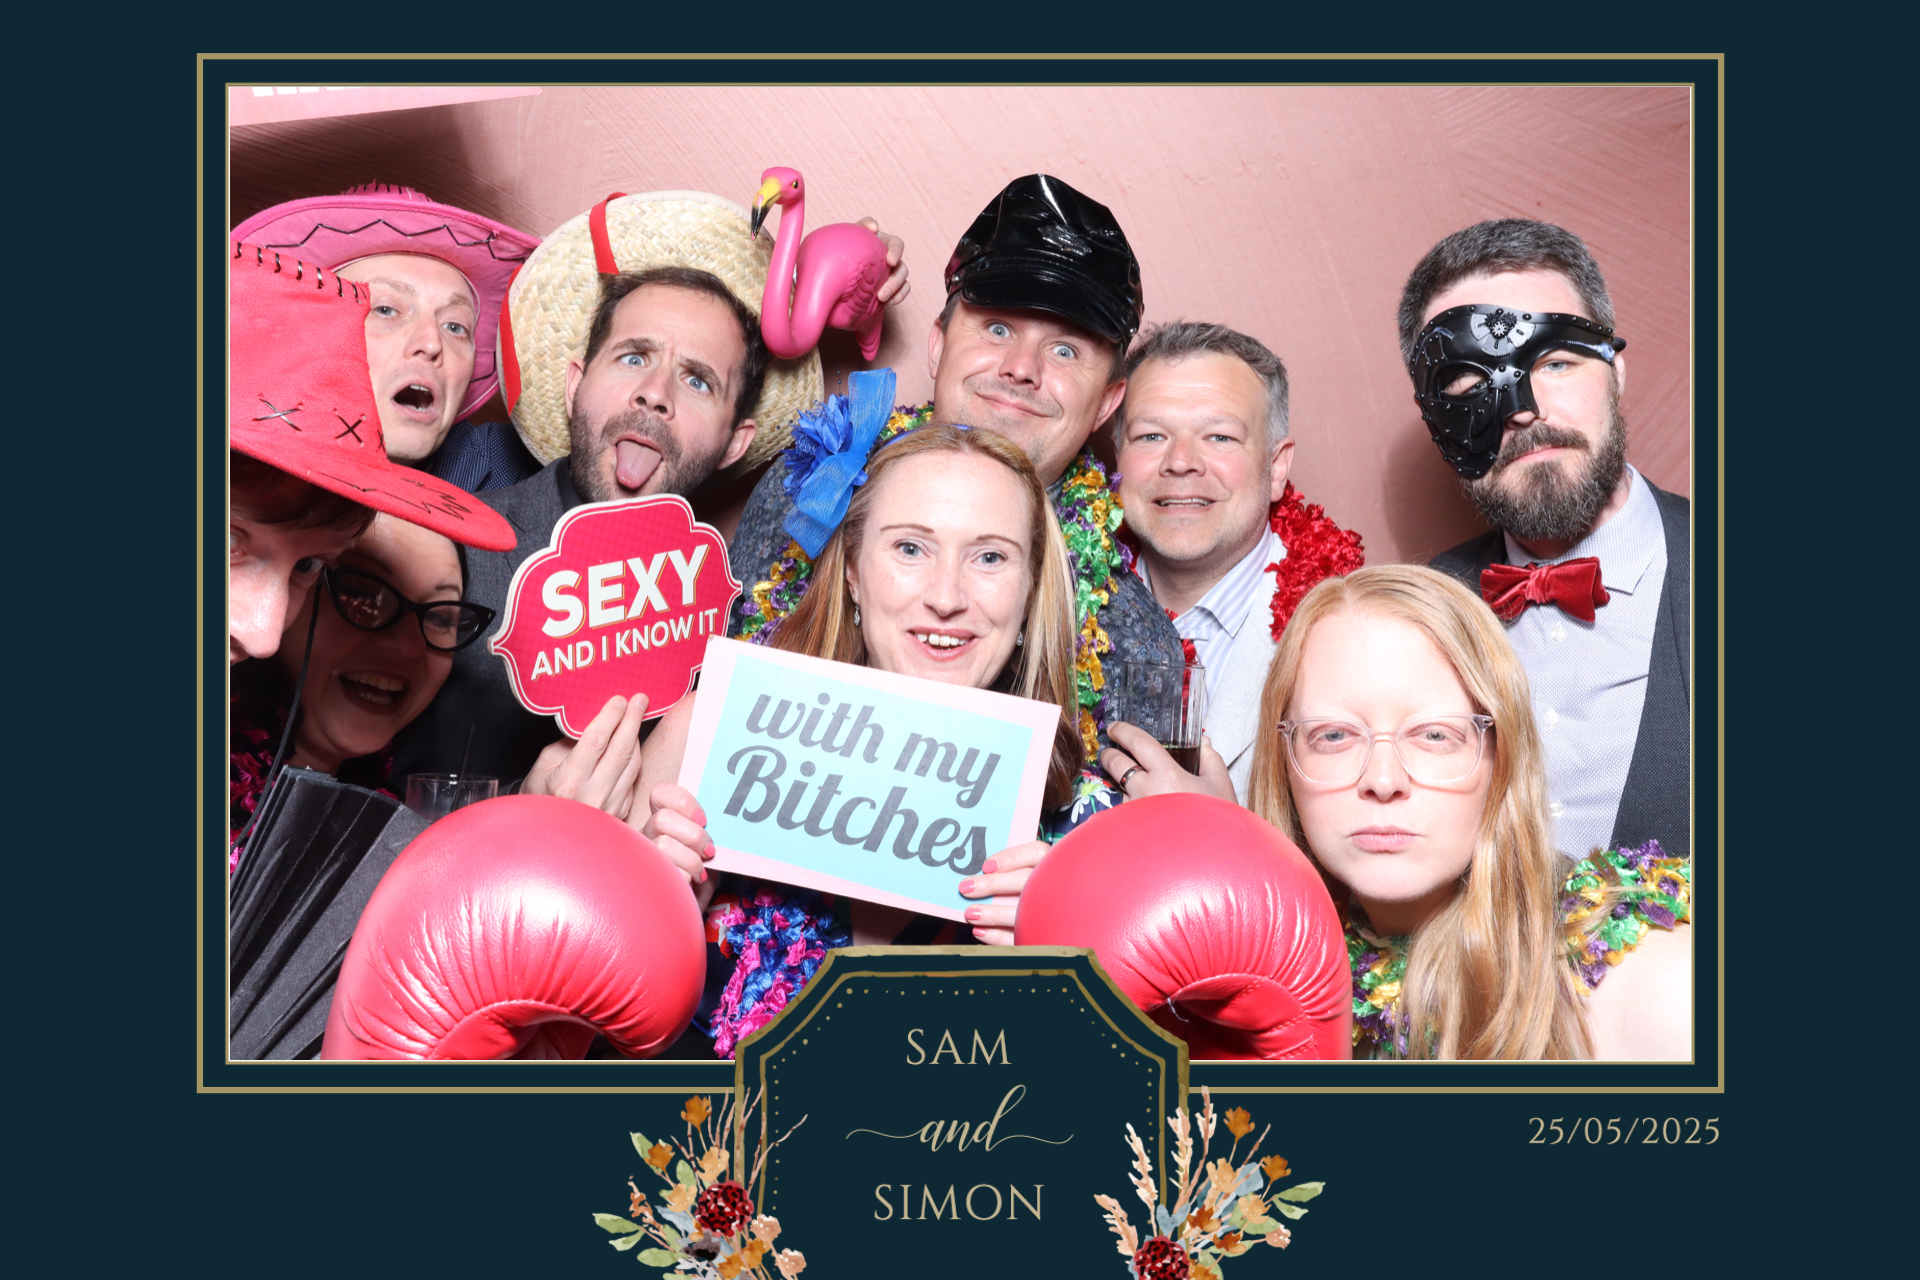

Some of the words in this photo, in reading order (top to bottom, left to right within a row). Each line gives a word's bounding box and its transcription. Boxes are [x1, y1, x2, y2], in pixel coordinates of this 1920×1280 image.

[530, 639, 596, 682] AND
[601, 635, 609, 662] I
[615, 613, 695, 659] KNOW
[698, 607, 719, 636] IT
[541, 543, 711, 640] SEXY
[745, 691, 885, 764] with
[893, 732, 1003, 810] my
[722, 744, 988, 876] Bitches
